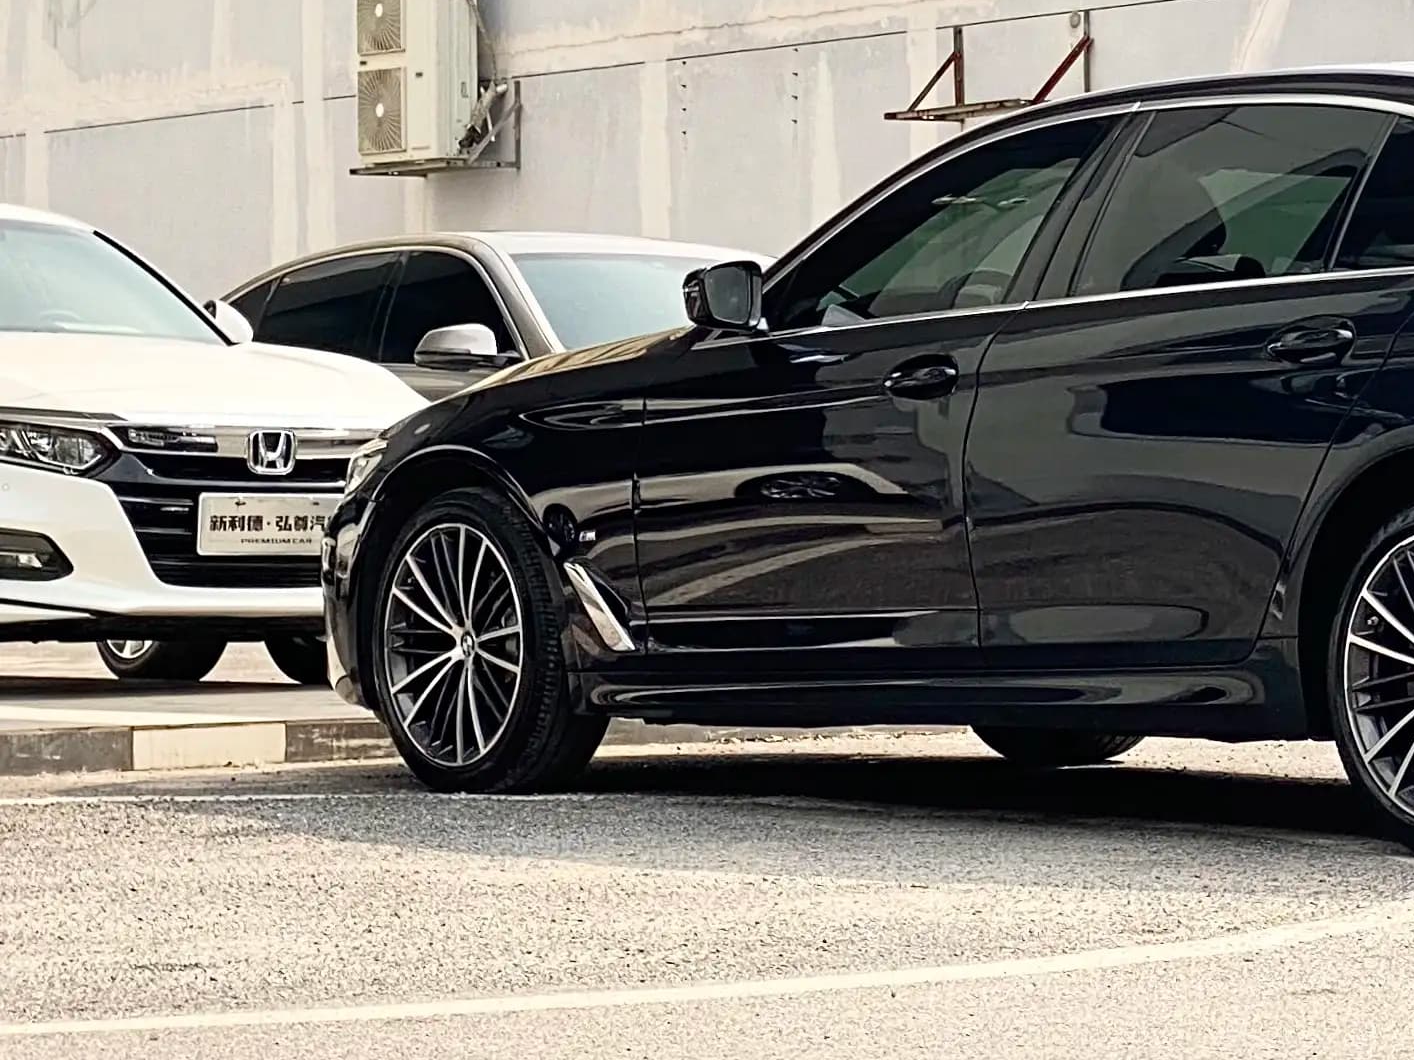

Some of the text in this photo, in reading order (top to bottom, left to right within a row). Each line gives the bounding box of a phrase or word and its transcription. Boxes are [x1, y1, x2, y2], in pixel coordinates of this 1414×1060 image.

[209, 515, 332, 532] 新利德·弘尊汽
